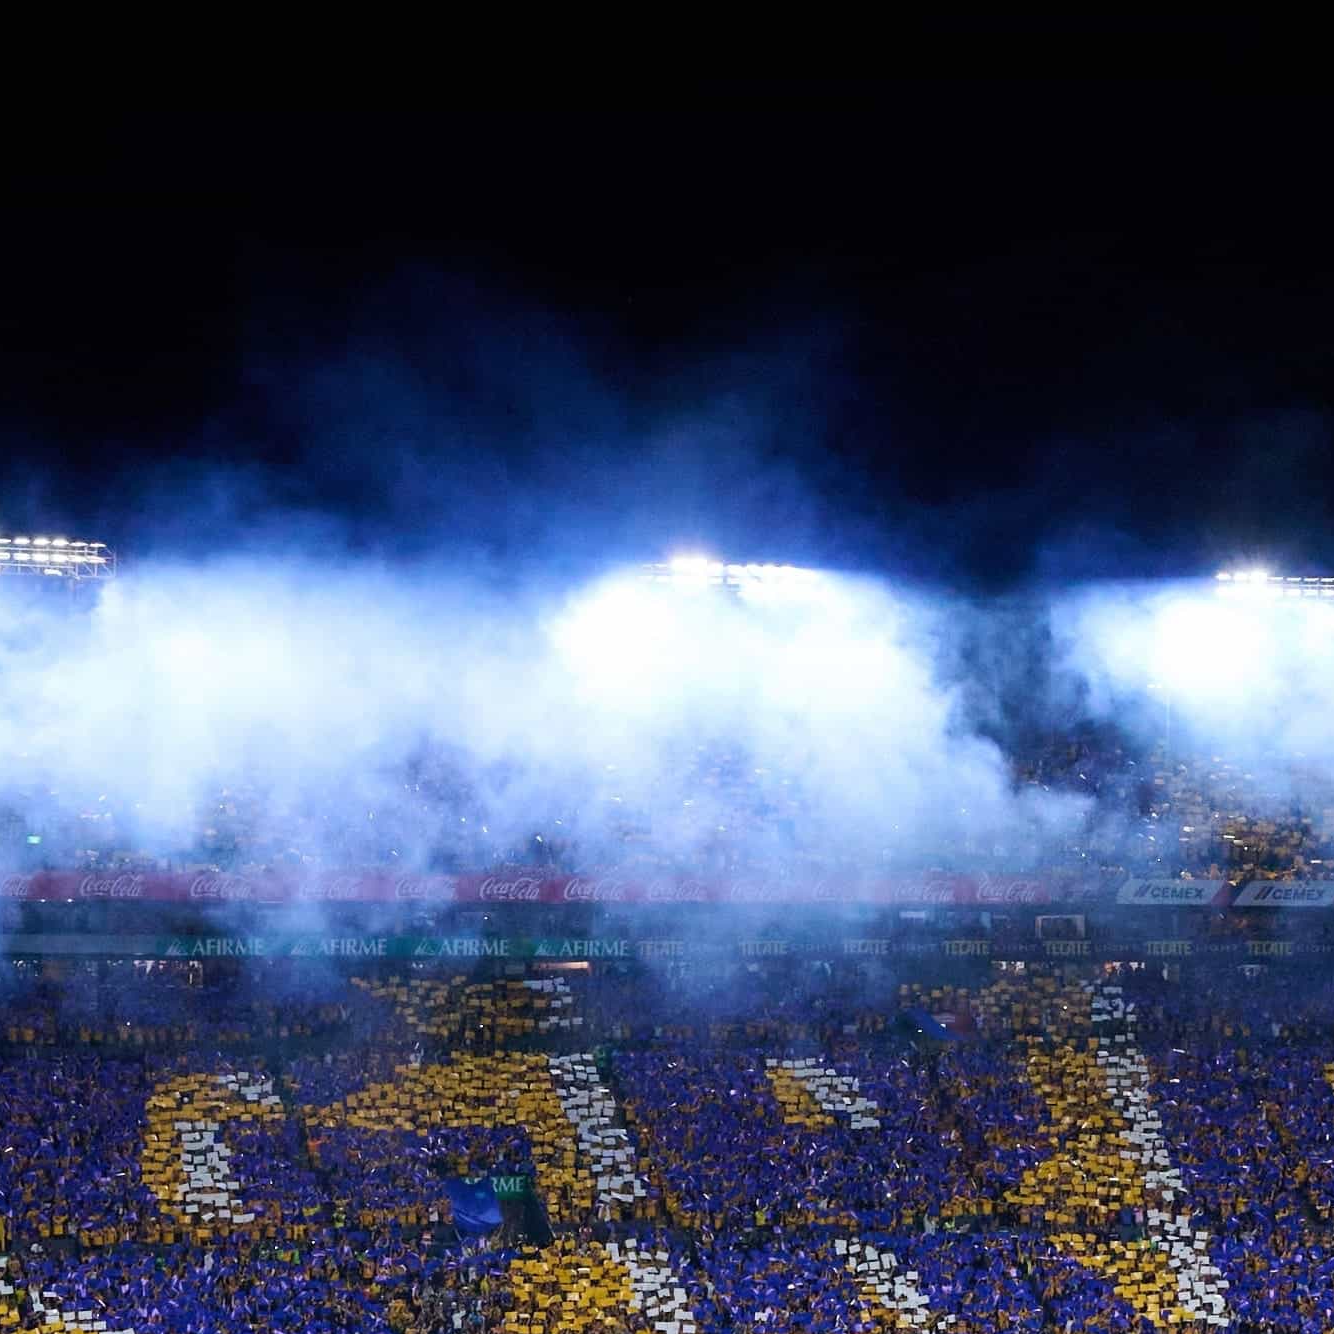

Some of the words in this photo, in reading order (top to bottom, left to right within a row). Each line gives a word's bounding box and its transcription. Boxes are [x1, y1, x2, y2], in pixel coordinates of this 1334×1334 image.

[80, 875, 144, 897] Coca-Cola
[189, 875, 252, 898] Coca-Cola
[479, 877, 540, 900] Coca-Cola
[563, 878, 625, 900] Coca-Cola
[976, 879, 1037, 902] Coca-Cola
[191, 938, 265, 956] AFIRME
[320, 939, 388, 956] AFIRME
[440, 940, 509, 957] AFIRME
[562, 941, 627, 957] AFIRME
